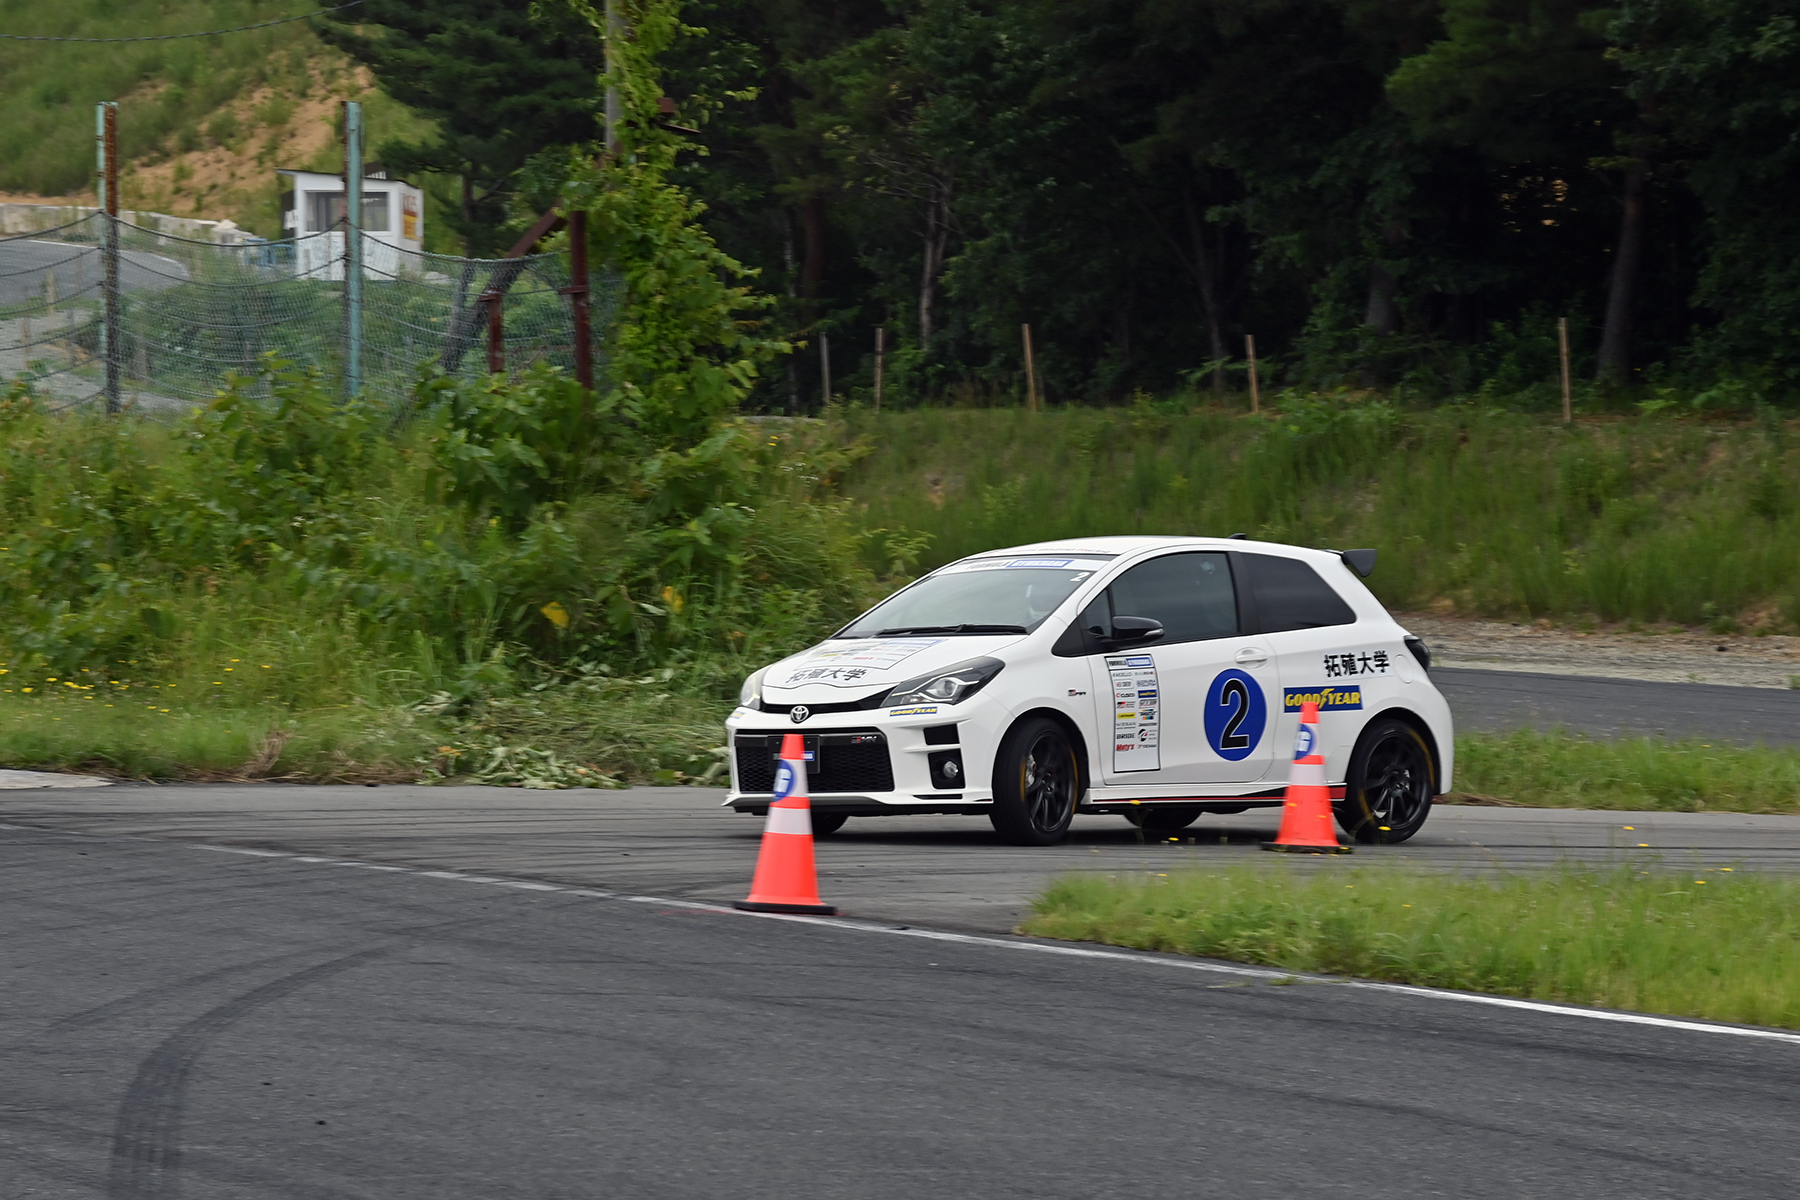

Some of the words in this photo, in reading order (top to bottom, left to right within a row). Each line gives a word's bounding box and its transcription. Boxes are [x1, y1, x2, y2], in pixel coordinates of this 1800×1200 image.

[1069, 571, 1091, 582] 2
[1323, 650, 1391, 677] 拓殖大学
[785, 667, 868, 684] 拓殖大学
[1220, 678, 1250, 750] 2
